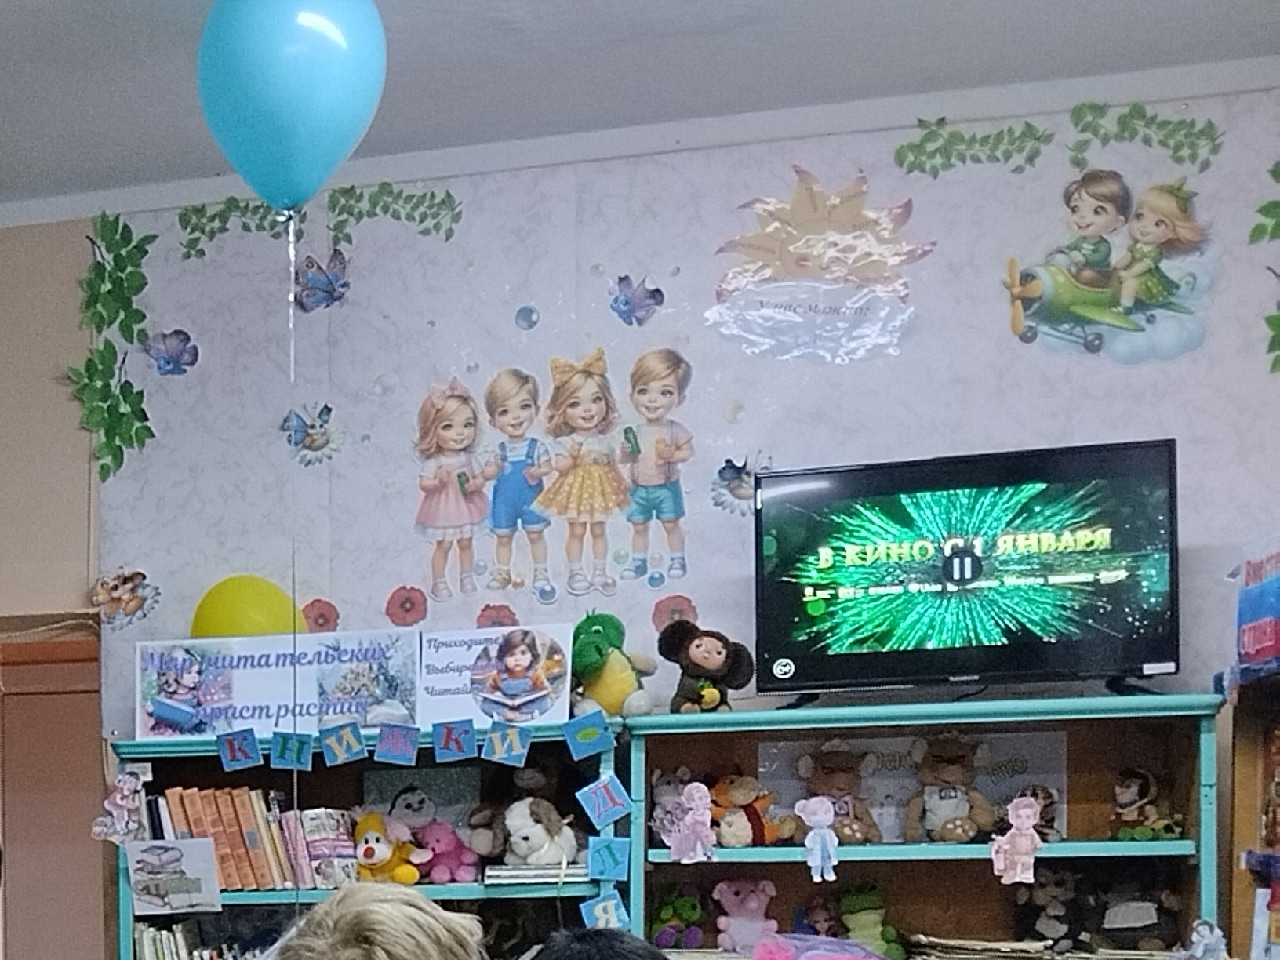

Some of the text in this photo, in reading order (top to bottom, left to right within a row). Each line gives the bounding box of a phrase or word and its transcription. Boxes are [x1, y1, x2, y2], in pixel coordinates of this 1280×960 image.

[818, 548, 833, 569] В
[844, 540, 934, 566] КИНО
[995, 528, 1112, 557] ЯНВАРЯ
